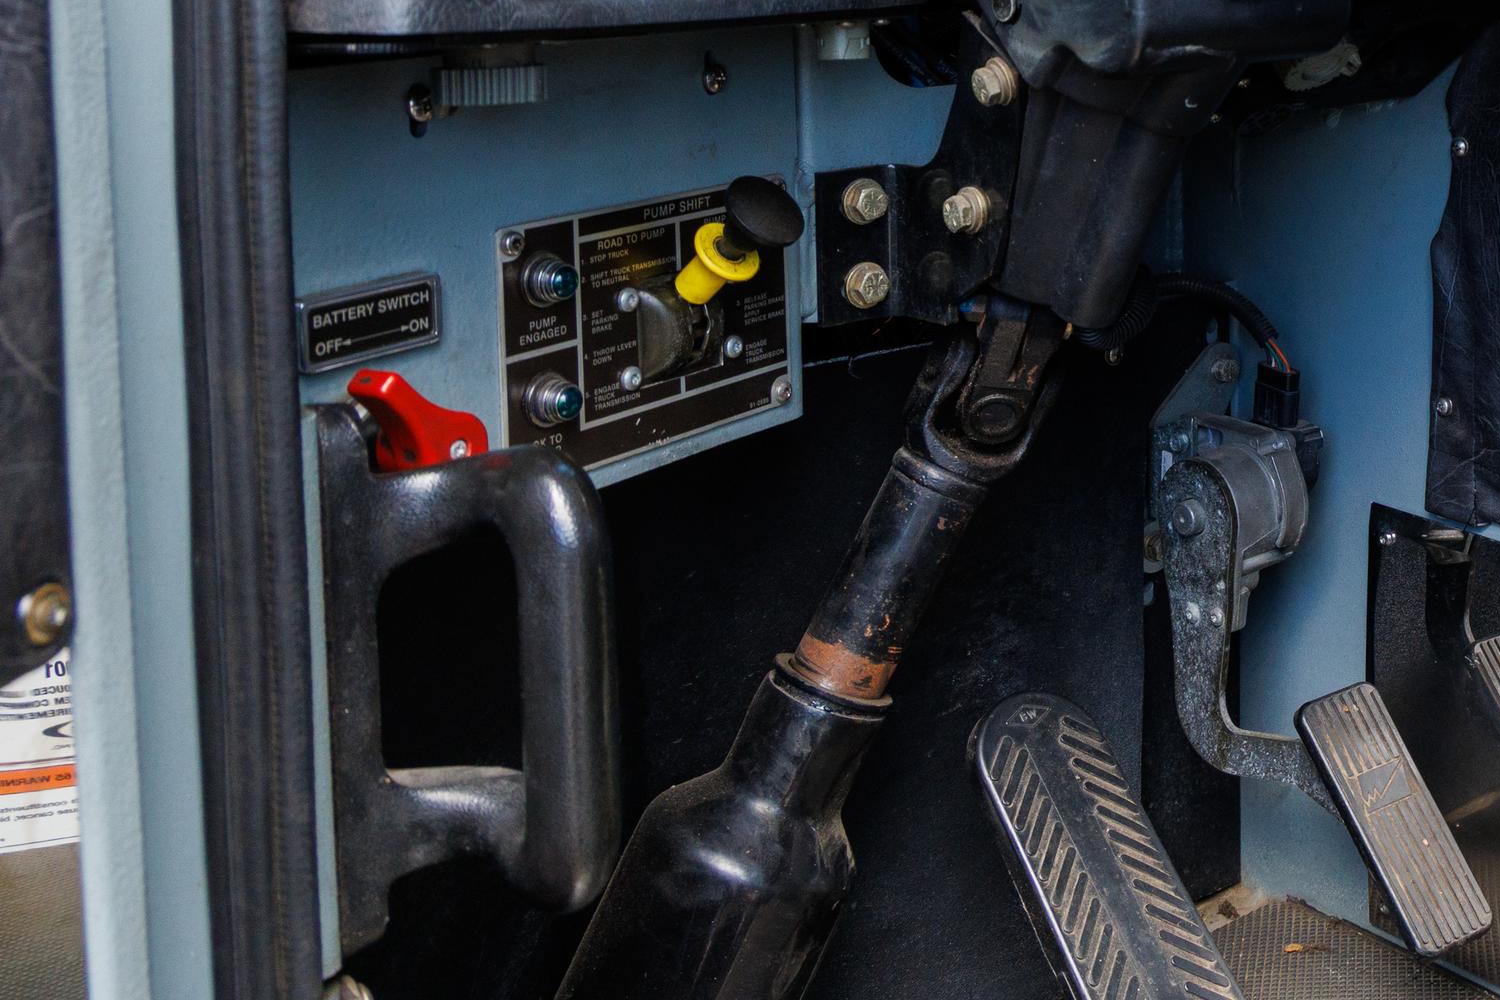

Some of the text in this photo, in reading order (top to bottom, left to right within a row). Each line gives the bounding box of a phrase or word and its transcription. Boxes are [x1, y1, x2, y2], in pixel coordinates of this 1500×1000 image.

[643, 195, 712, 221] PUMP SHIFT
[597, 228, 666, 251] ROAD TO PUMP
[589, 254, 607, 264] STOP
[608, 249, 629, 259] TRUCK
[590, 271, 609, 282] SHIFT
[610, 267, 632, 277] TRUCK
[632, 256, 677, 273] TRANSMISSION
[591, 275, 630, 289] TO NEUTRAL
[312, 289, 430, 329] BATTERY SWITCH
[591, 310, 604, 319] SET
[529, 315, 557, 331] PUMP
[591, 314, 619, 326] PARKING
[519, 324, 568, 346] ENGAGED
[591, 323, 612, 334] BRAKE
[315, 317, 429, 356] OFF ON
[592, 346, 616, 357] THROW
[617, 340, 637, 352] LEVER
[745, 339, 768, 351] ENGAGE
[745, 348, 763, 358] TRUCK
[592, 355, 613, 366] DOWN
[594, 383, 620, 395] ENGAGE
[594, 392, 615, 403] TRUCK
[594, 392, 641, 411] TRANSMISSION
[550, 433, 563, 445] TO
